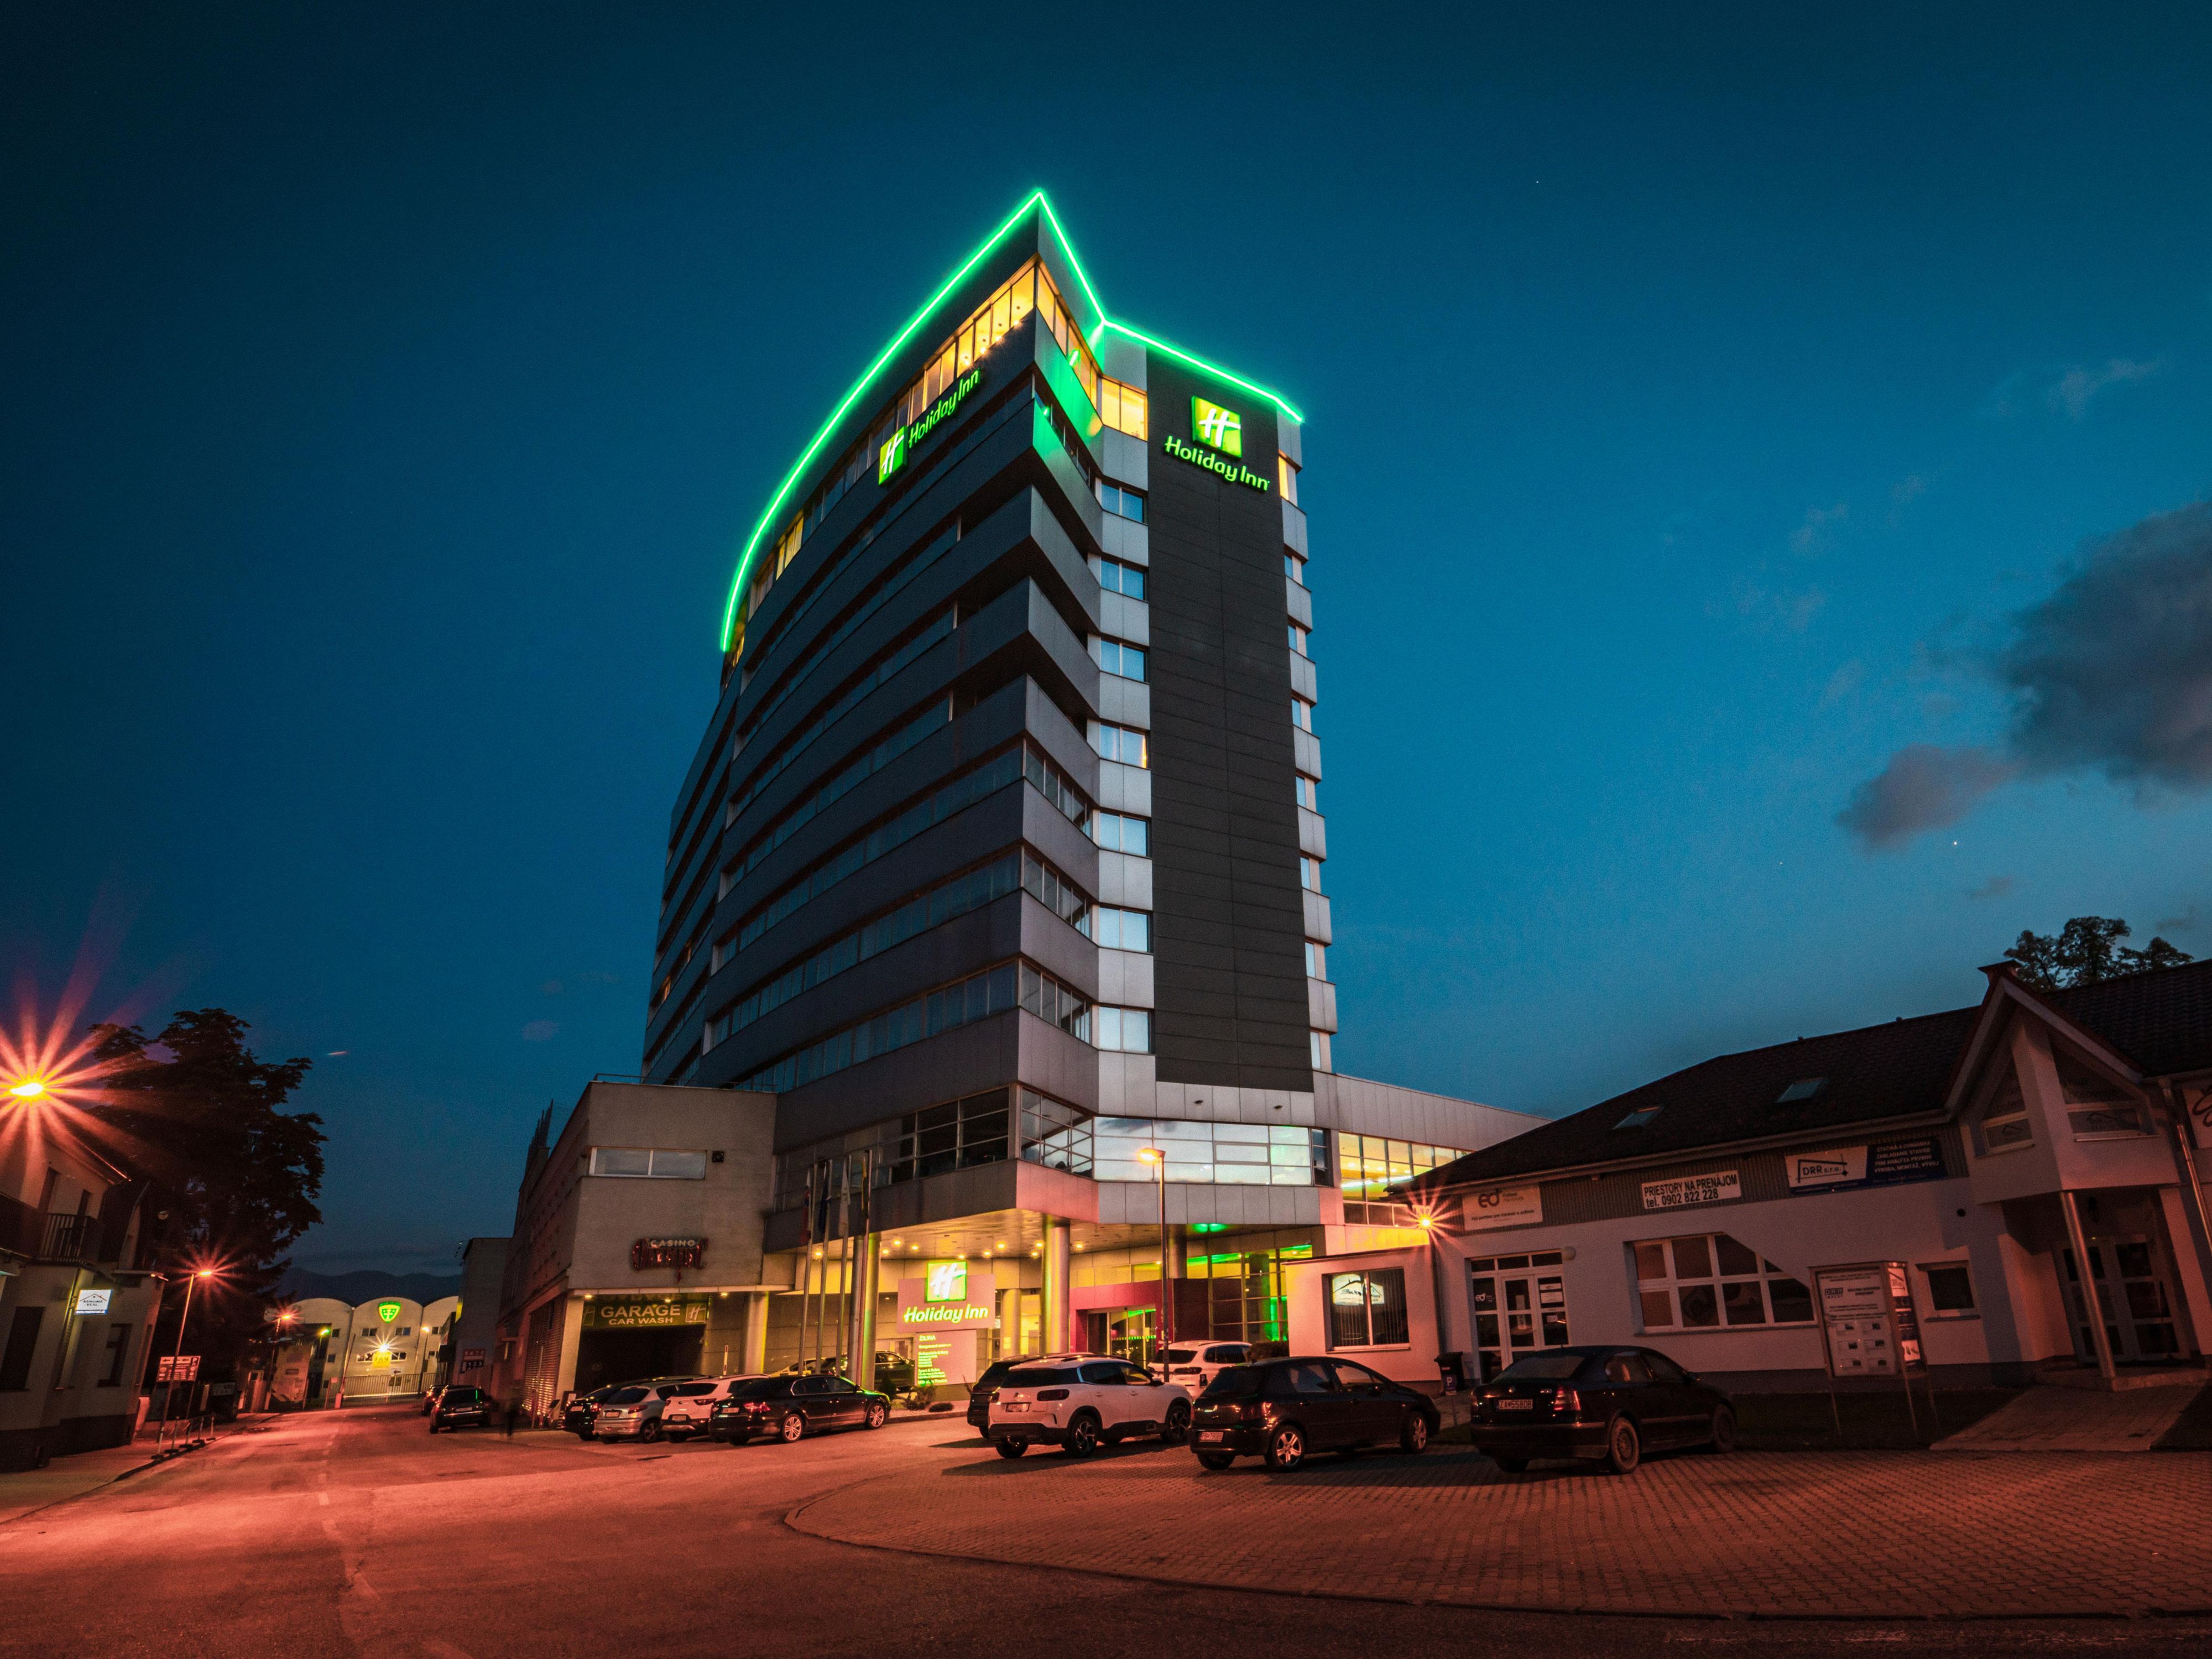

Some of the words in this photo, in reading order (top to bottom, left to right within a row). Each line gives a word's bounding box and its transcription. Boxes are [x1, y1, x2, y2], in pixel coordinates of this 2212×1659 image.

[909, 392, 957, 448] Holiday
[958, 370, 978, 401] Inn
[1165, 435, 1238, 482] Holiday
[1240, 465, 1267, 491] Inn
[1803, 1165, 1822, 1175] DRR
[1644, 1182, 1682, 1197] PRIESTORY
[1684, 1181, 1694, 1191] NA
[1696, 1173, 1738, 1189] PRENÁJOM
[1646, 1197, 1659, 1207] tel.
[1662, 1194, 1682, 1205] 0902
[1684, 1191, 1700, 1202] 822
[1702, 1189, 1719, 1200] 228
[601, 1305, 681, 1318] GARAGE
[904, 1305, 963, 1324] Holiday
[964, 1303, 988, 1319] Inn
[1447, 1376, 1452, 1386] P
